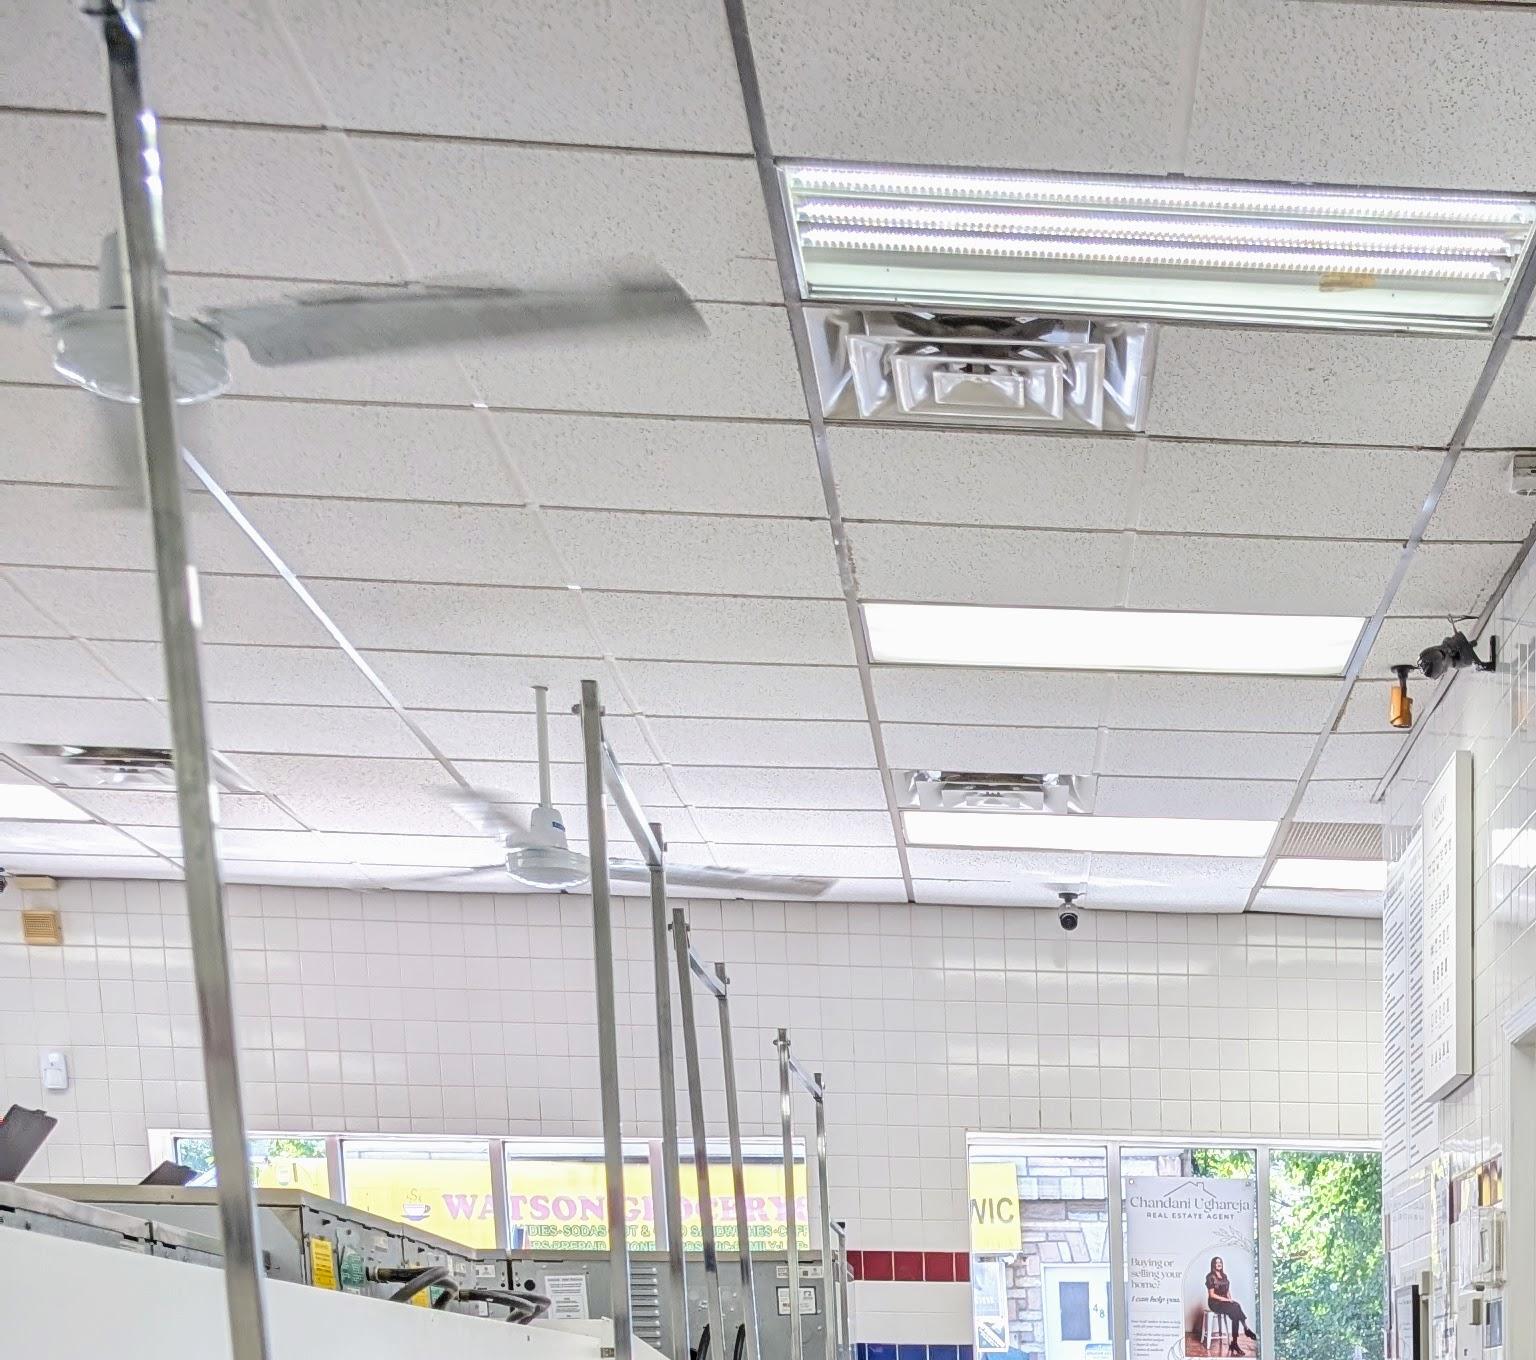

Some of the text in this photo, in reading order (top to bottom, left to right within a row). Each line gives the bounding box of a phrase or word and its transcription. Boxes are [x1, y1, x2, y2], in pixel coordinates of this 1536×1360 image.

[1130, 1196, 1193, 1210] Chandani
[1146, 1211, 1168, 1219] REAL
[1131, 1258, 1163, 1269] Buying
[1131, 1269, 1182, 1280] selling your
[1150, 1296, 1165, 1304] help
